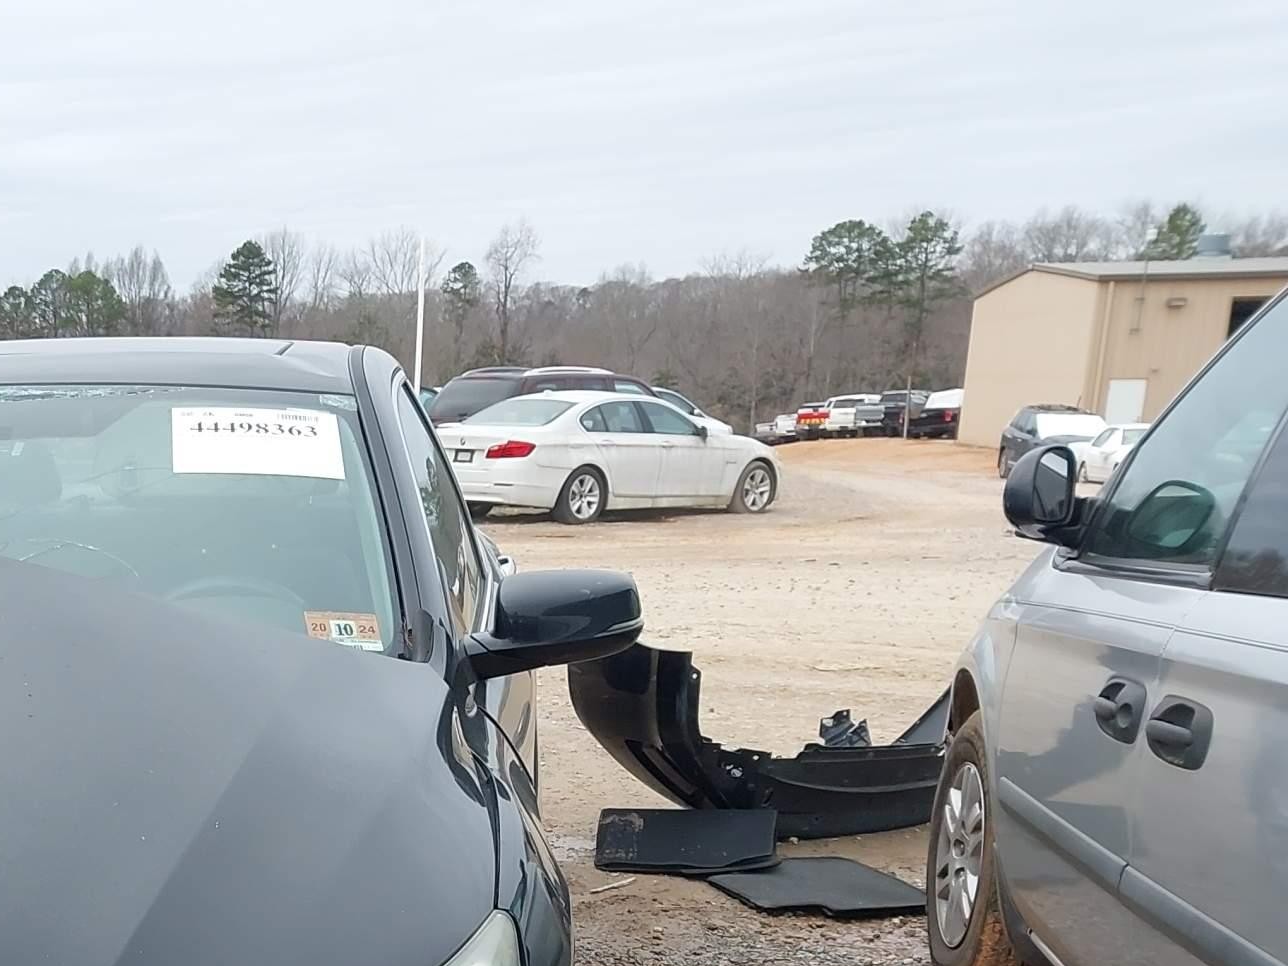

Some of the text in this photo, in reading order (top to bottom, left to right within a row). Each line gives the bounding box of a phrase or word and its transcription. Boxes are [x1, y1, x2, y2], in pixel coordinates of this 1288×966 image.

[190, 421, 318, 438] 44498363
[311, 622, 376, 636] 20 10 24
